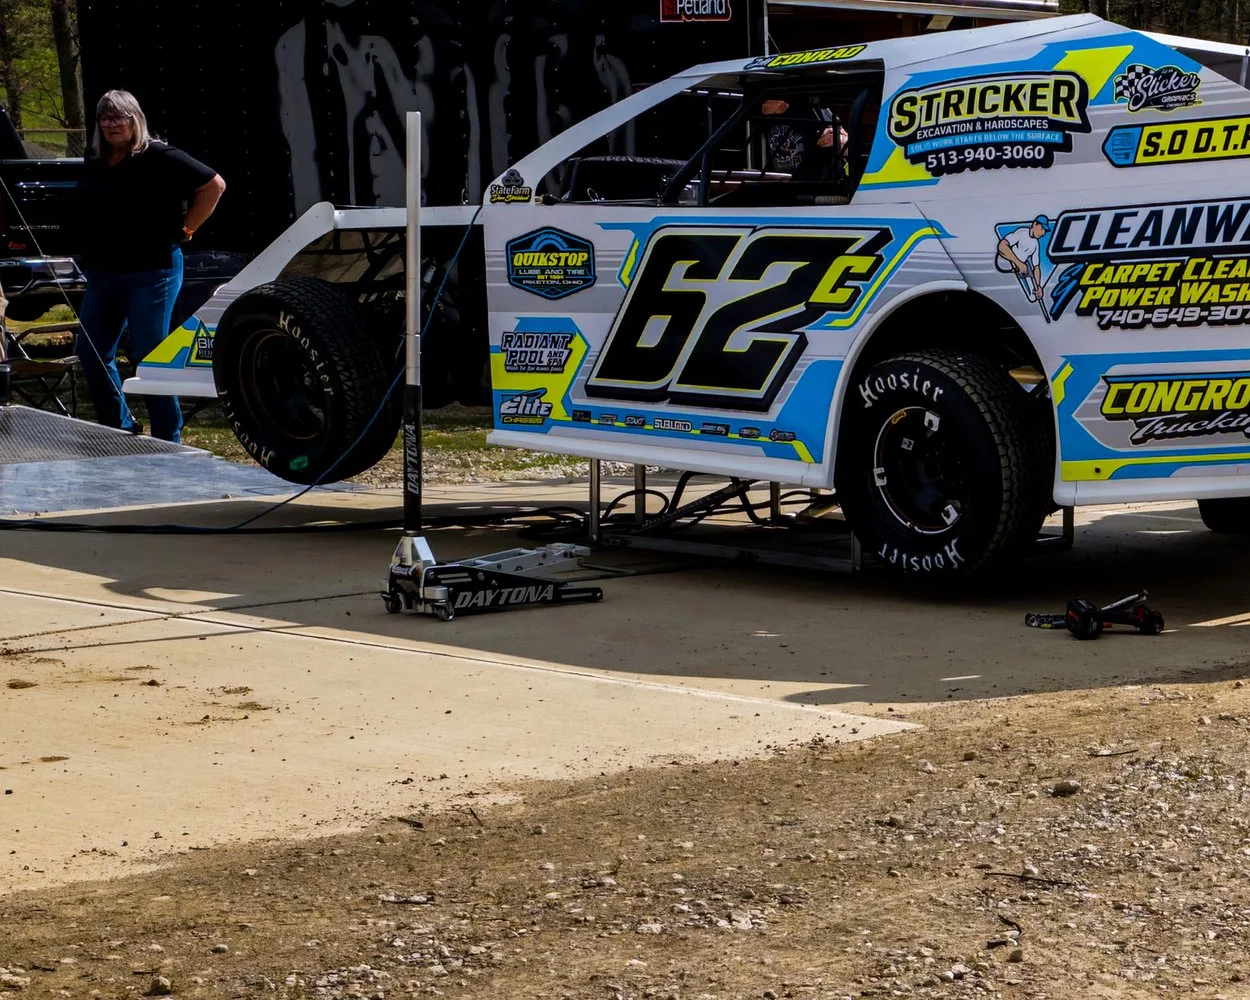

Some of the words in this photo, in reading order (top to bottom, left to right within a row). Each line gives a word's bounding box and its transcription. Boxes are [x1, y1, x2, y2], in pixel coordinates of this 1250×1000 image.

[768, 45, 868, 68] CONRAD
[1128, 70, 1201, 112] Slicker
[1161, 94, 1196, 103] GRAPHICS
[893, 78, 1077, 134] STRICKER
[916, 120, 973, 140] EXCAVATION
[975, 123, 982, 131] &
[984, 119, 1049, 130] HARDSCAPES
[910, 142, 931, 152] SOLID
[932, 139, 954, 149] WORK
[955, 136, 983, 146] STARTS
[984, 133, 1007, 142] BELOW
[1011, 132, 1025, 141] THE
[1027, 131, 1060, 141] SURFACE
[927, 146, 1045, 168] 513-940-3060
[513, 252, 589, 267] QUIKSTOP
[1080, 262, 1181, 286] CARPET
[1079, 285, 1178, 309] POWER
[503, 333, 571, 349] RADIANT
[279, 310, 335, 396] Hoosier
[506, 349, 547, 366] POOL
[546, 357, 563, 366] SPA
[547, 350, 564, 358] AND
[859, 367, 944, 409] Hoosier
[500, 395, 553, 417] Elite
[405, 423, 420, 495] DAYTONA
[454, 584, 554, 609] DAYTONA
